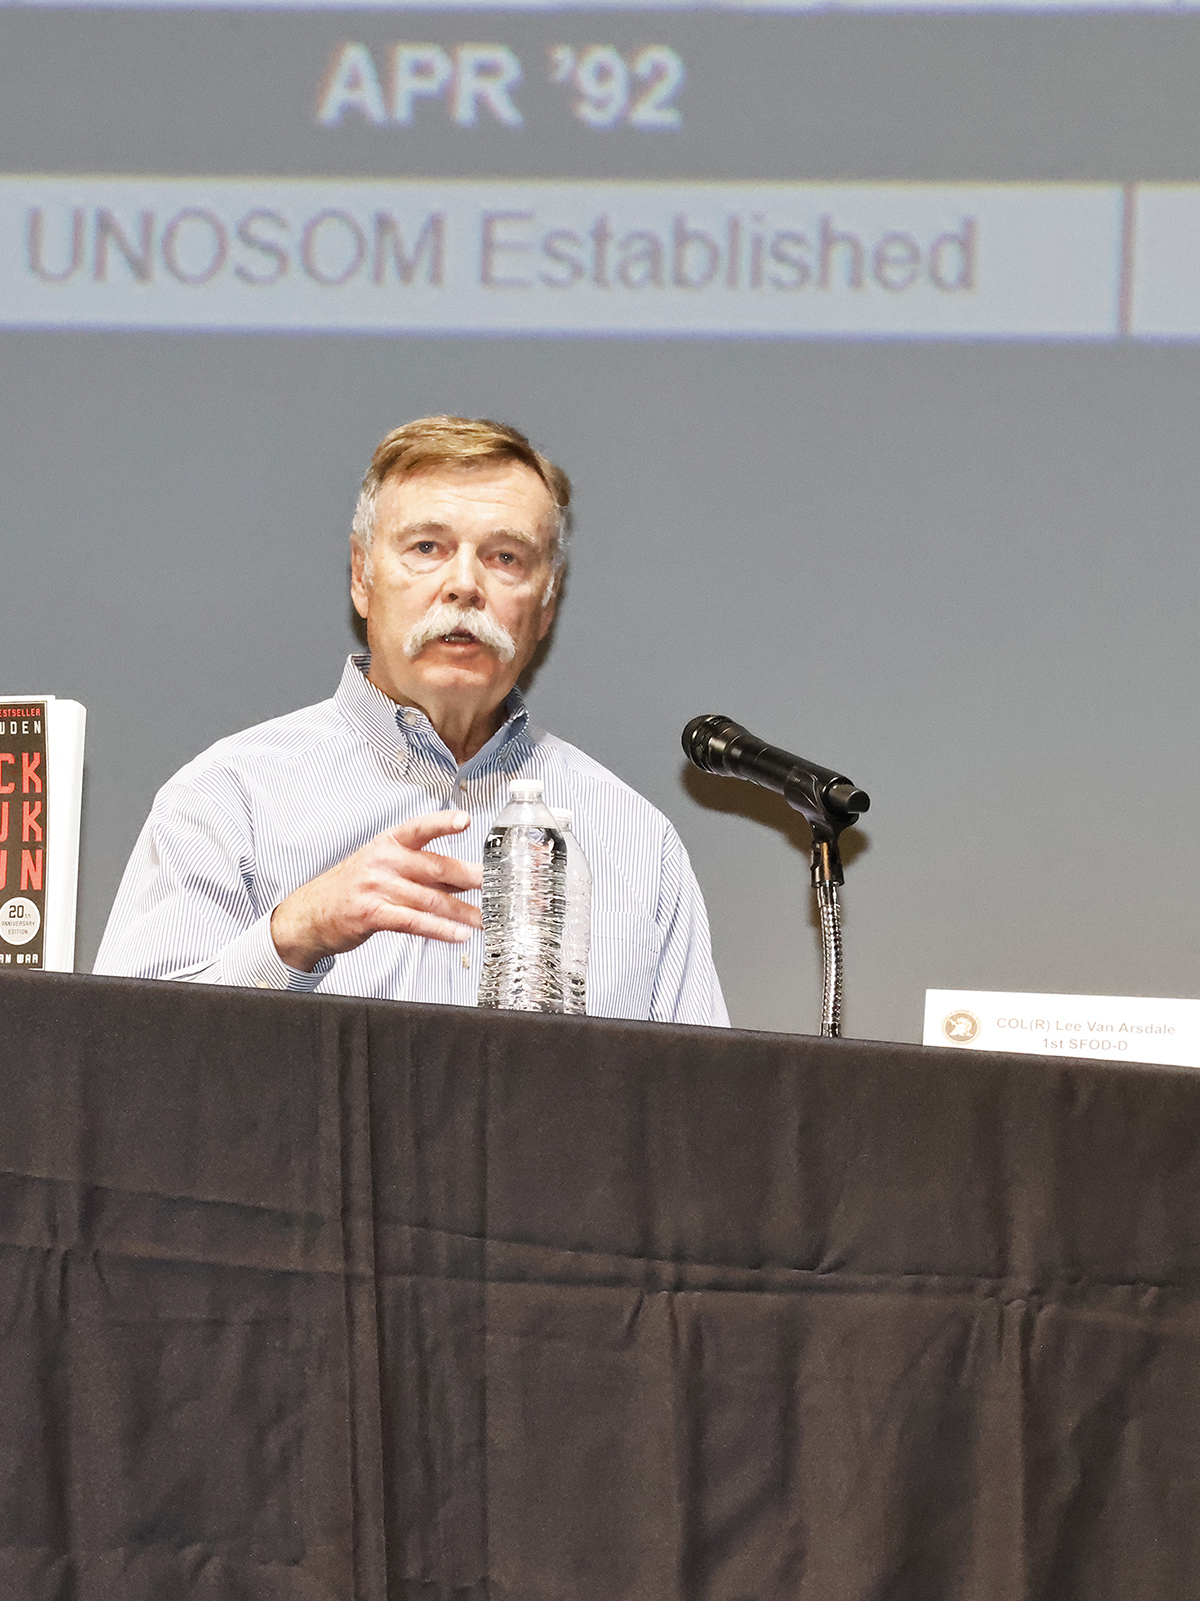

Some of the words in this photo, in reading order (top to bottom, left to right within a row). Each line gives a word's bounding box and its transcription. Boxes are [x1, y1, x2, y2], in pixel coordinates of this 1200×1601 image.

[316, 43, 524, 129] APR
[26, 205, 445, 286] UNOSOM
[480, 209, 977, 292] Established
[16, 953, 39, 964] WAR
[996, 1017, 1050, 1032] COL(R)
[1056, 1020, 1082, 1032] Lee
[1087, 1021, 1114, 1032] Van
[1118, 1022, 1176, 1035] Arsdale
[1042, 1038, 1063, 1049] 1st
[1069, 1038, 1128, 1051] SFOD-D
